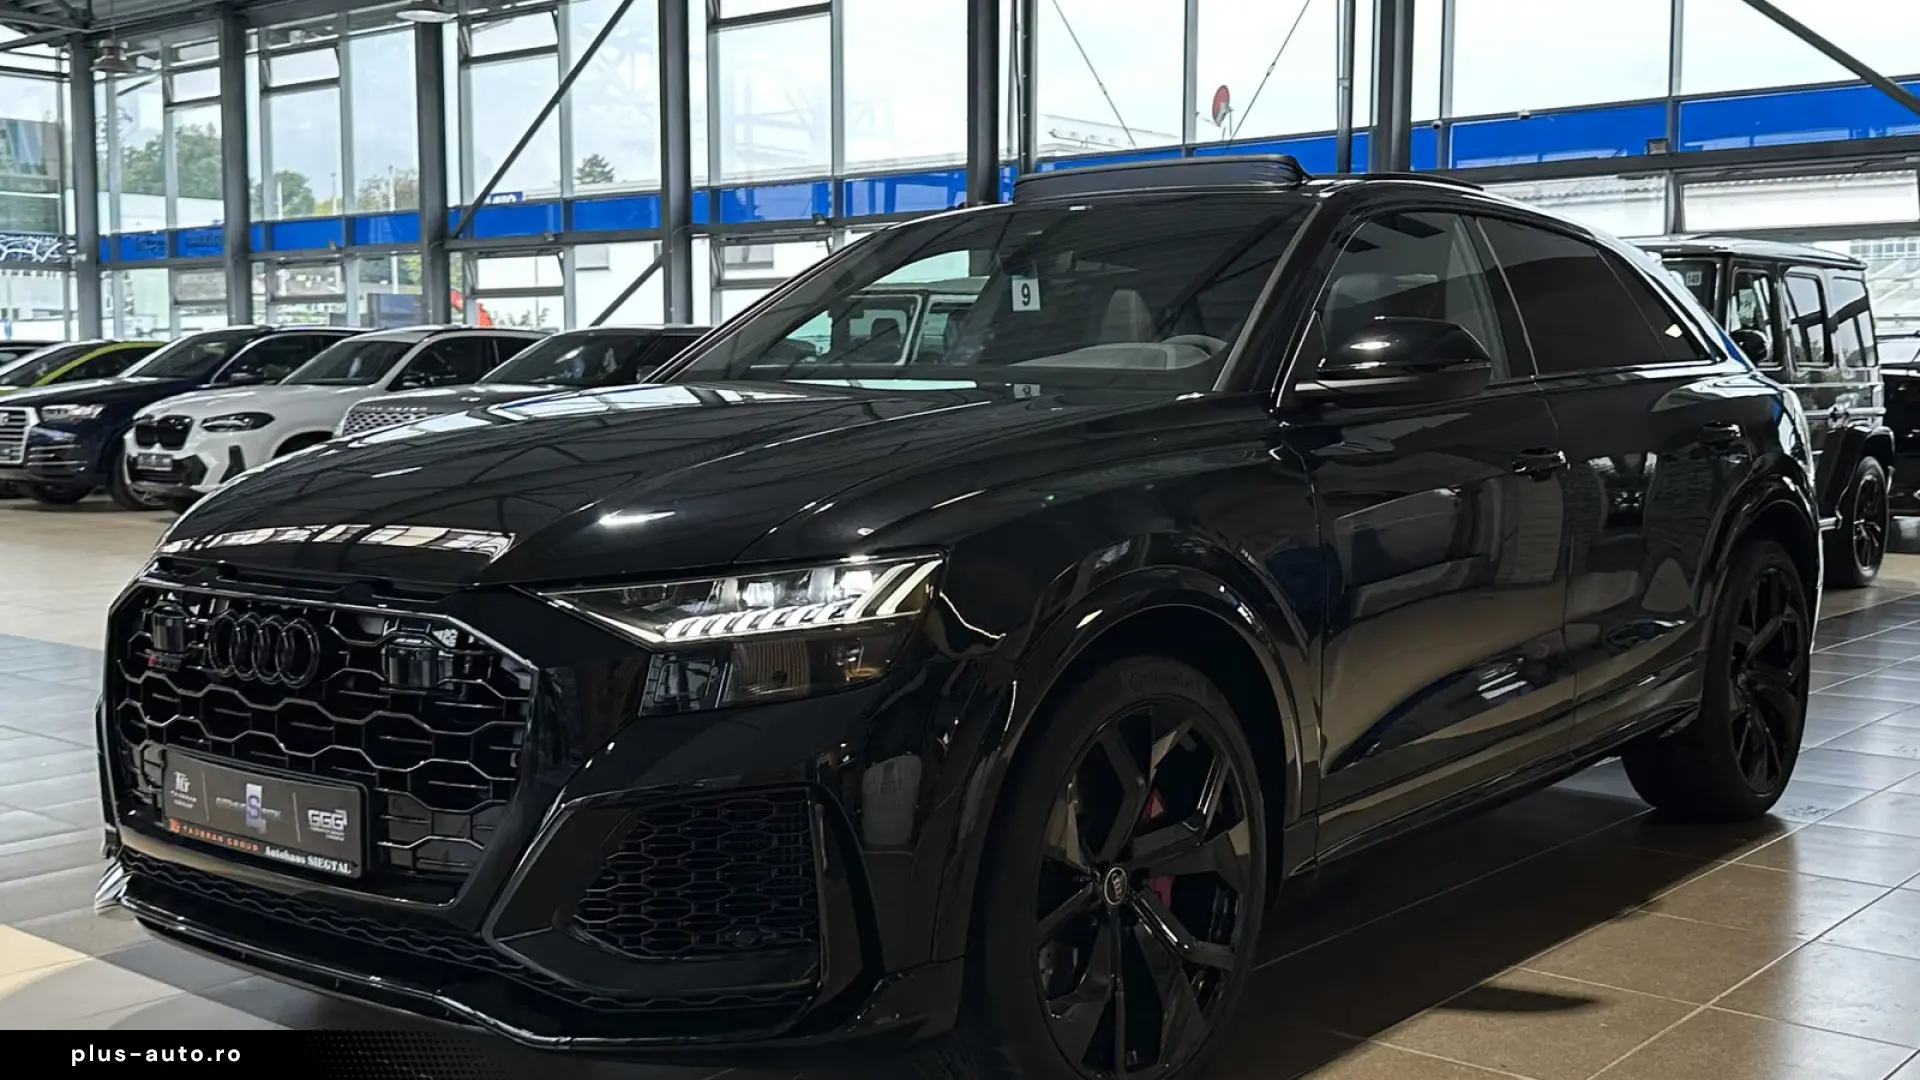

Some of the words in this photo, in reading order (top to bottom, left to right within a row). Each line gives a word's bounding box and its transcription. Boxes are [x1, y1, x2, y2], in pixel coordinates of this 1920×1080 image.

[1021, 282, 1032, 307] 9
[307, 809, 347, 830] GGG
[227, 836, 260, 852] GROUP
[264, 845, 306, 865] Autohaus
[307, 855, 352, 874] SIEGTAL
